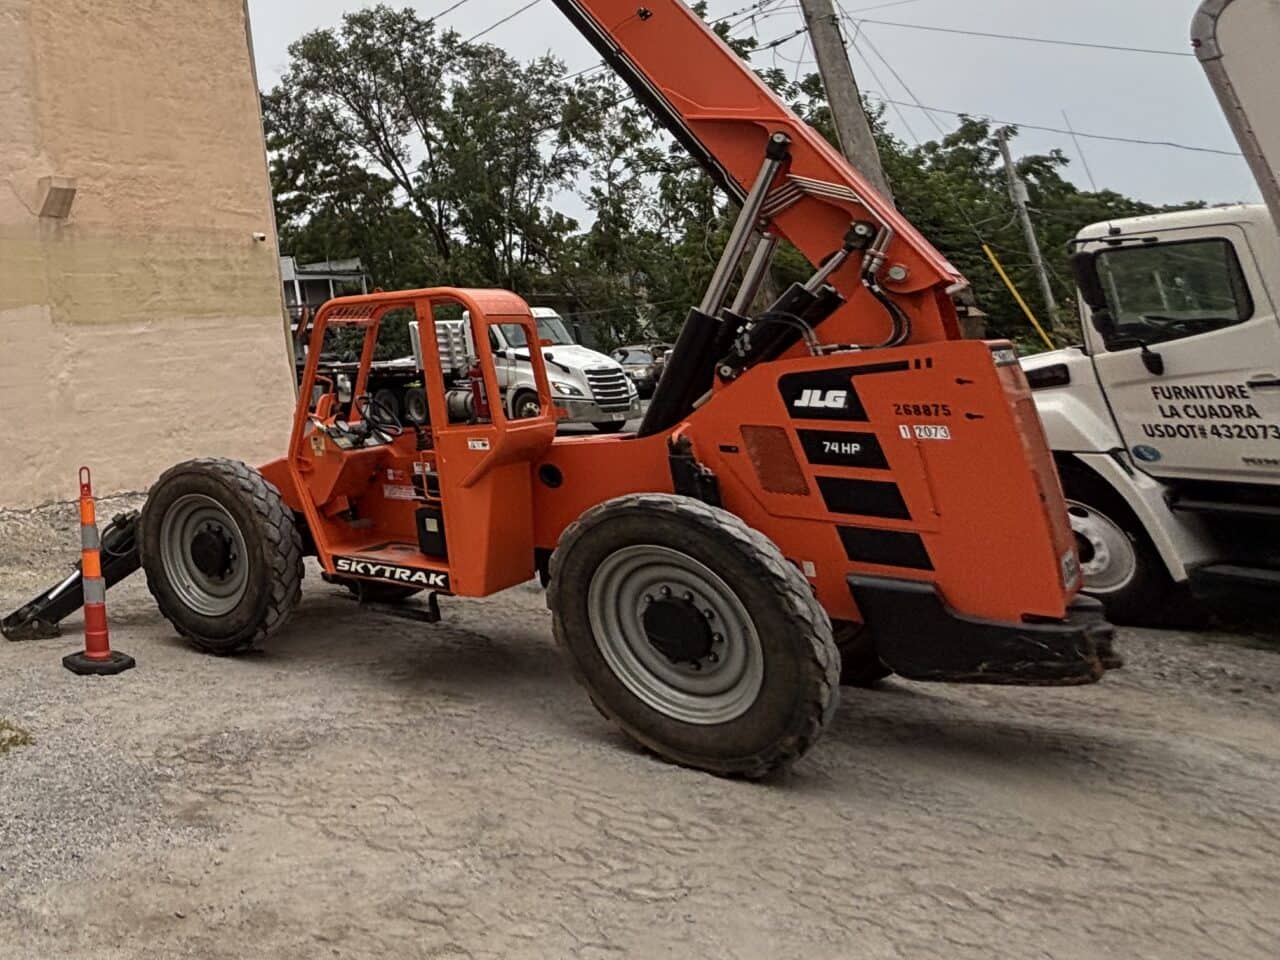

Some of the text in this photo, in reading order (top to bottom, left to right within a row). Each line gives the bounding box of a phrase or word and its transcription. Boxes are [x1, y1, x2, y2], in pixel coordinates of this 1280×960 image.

[793, 389, 847, 408] JLG
[1151, 384, 1251, 400] FURNITURE
[893, 403, 952, 416] 268875
[1158, 404, 1262, 419] LA CUADRA
[337, 559, 447, 587] SKYTRAK
